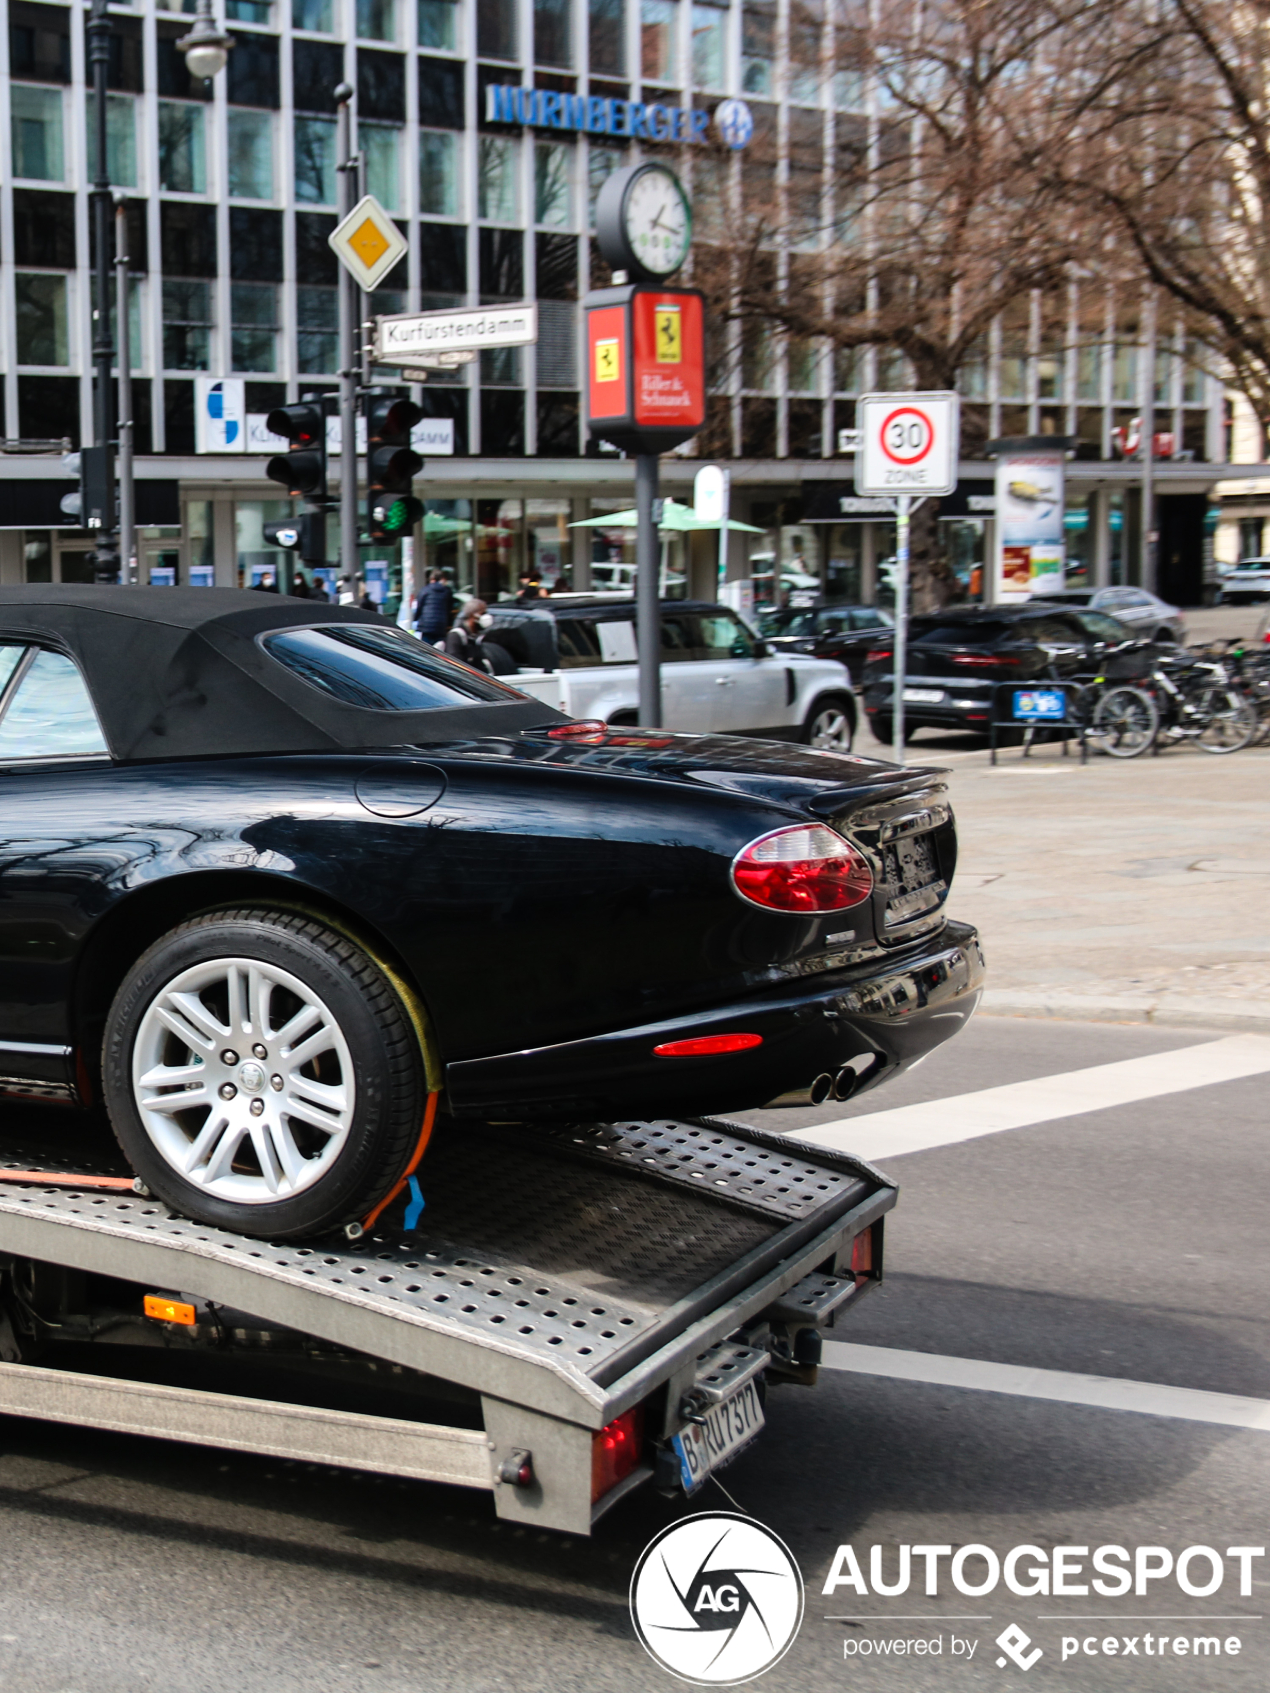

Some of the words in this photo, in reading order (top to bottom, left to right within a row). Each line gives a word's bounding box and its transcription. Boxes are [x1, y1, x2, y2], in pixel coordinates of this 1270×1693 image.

[387, 318, 526, 343] Kurfürstendamm
[890, 423, 923, 448] 30
[885, 469, 928, 484] ZONE
[682, 1433, 698, 1475] B
